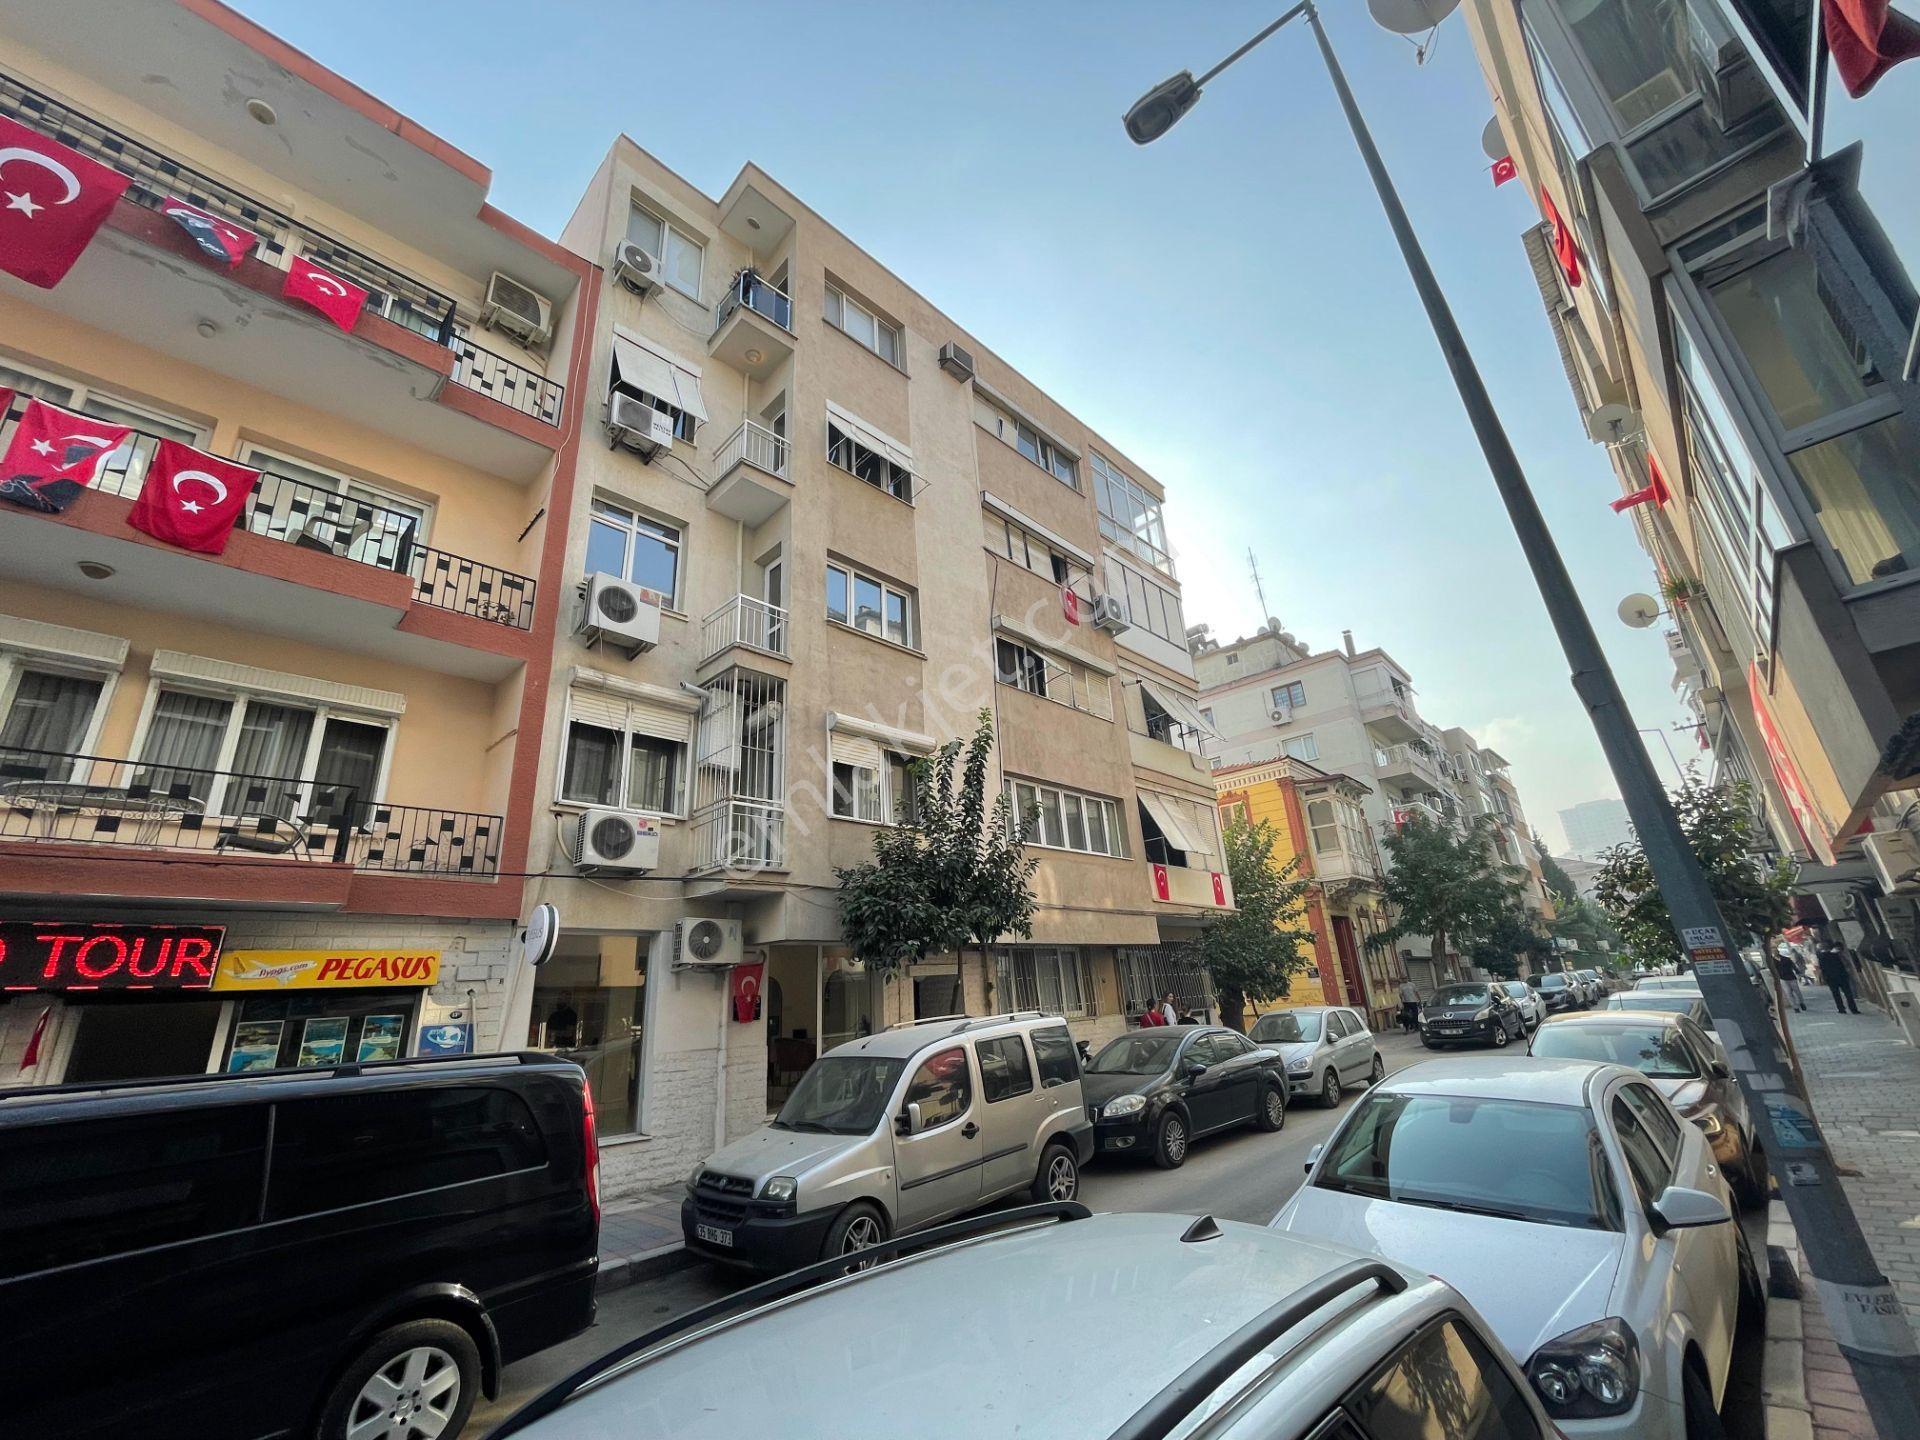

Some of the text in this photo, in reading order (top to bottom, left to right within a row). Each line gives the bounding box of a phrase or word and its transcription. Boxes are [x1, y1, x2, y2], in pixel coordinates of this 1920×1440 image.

[36, 935, 212, 978] TOUR
[316, 956, 436, 981] PEGASUS
[258, 962, 309, 977] flypgs.com
